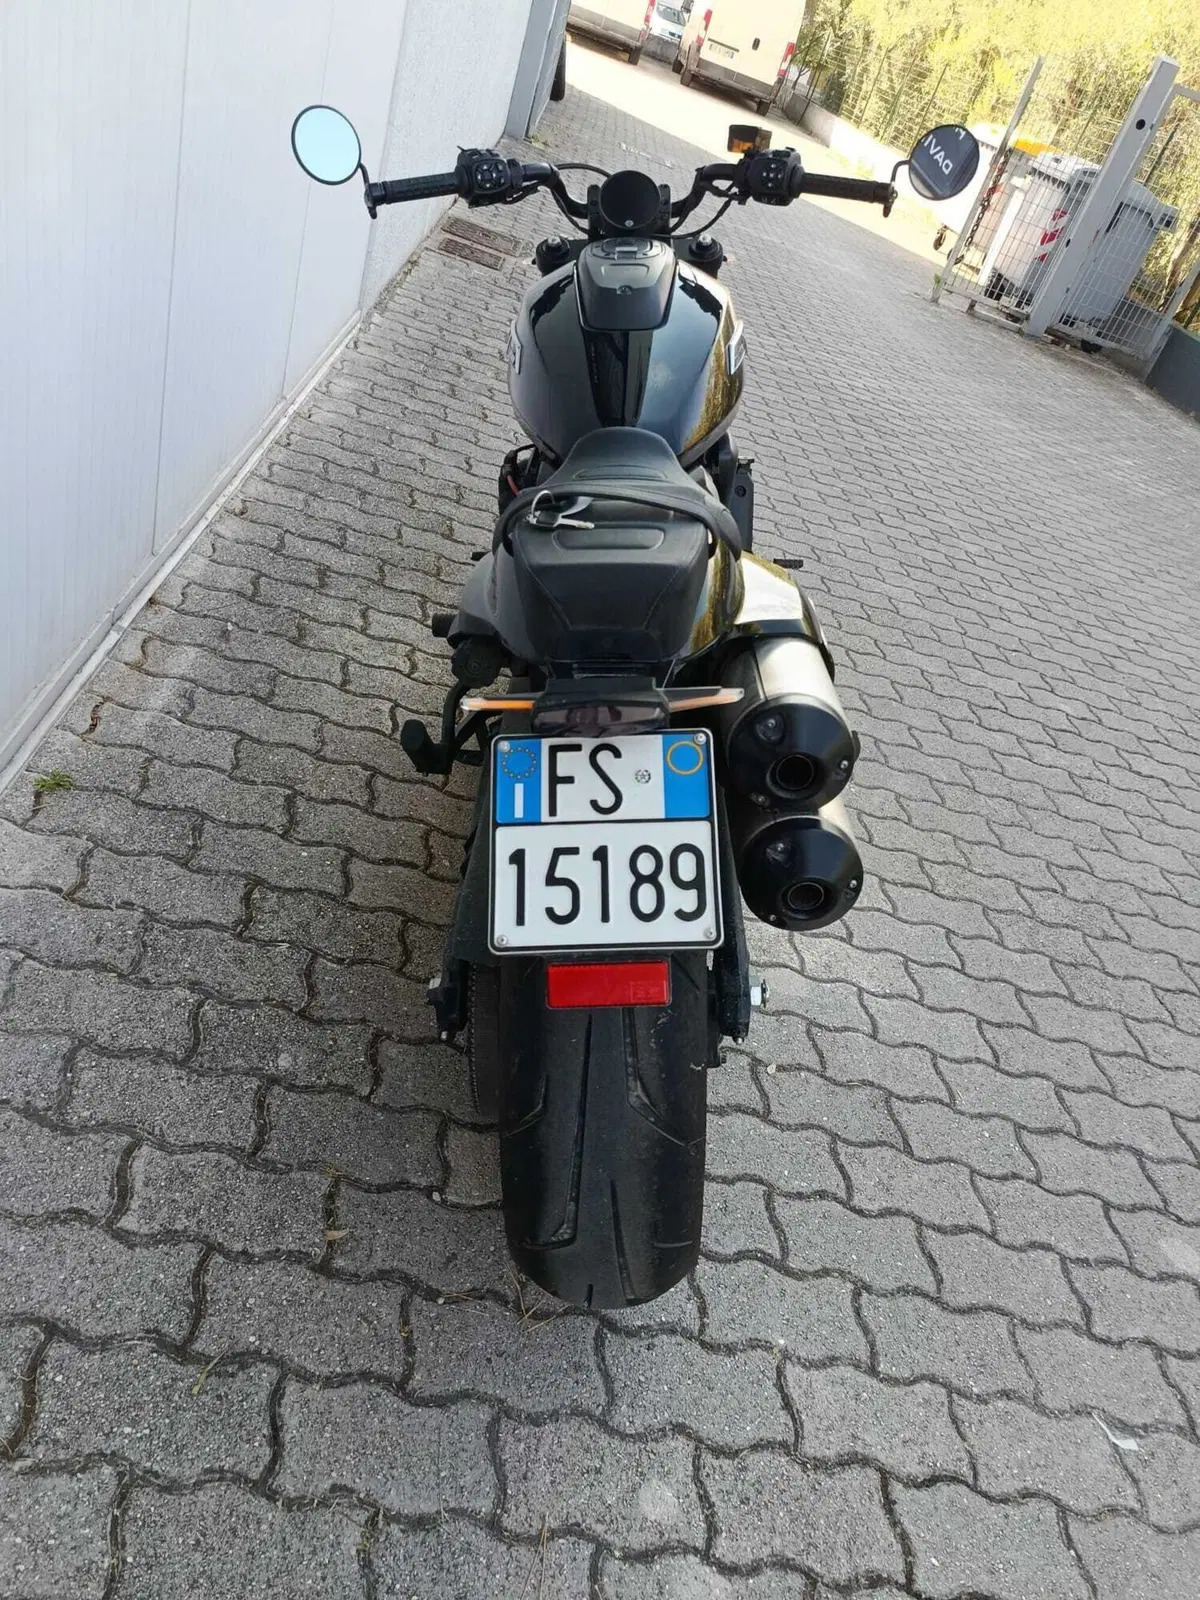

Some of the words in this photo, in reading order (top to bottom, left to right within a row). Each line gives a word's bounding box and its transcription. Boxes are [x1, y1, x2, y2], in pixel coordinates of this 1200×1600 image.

[514, 783, 524, 818] I
[548, 743, 623, 817] FS
[508, 843, 707, 927] 15189
